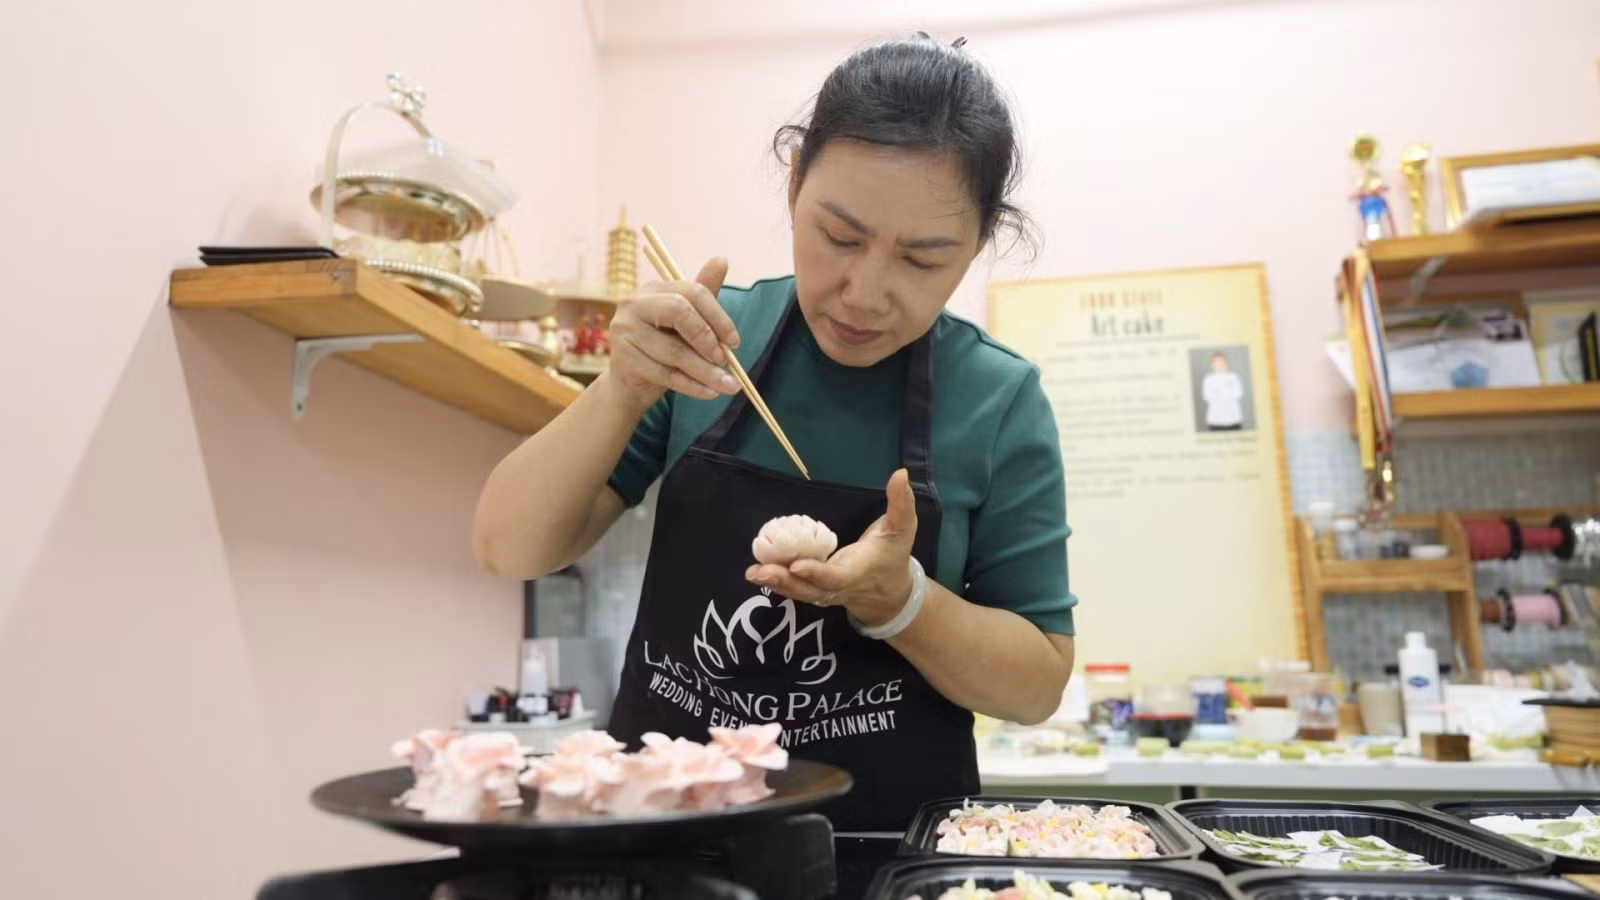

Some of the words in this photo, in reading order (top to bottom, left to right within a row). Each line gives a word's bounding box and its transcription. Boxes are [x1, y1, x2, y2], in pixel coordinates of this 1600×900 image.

[1091, 314, 1117, 336] Art
[1122, 309, 1165, 335] cake
[649, 671, 703, 718] WEDDING
[709, 709, 749, 731] EVE
[781, 710, 896, 748] NTERTAINMENT
[785, 679, 903, 721] PALACE
